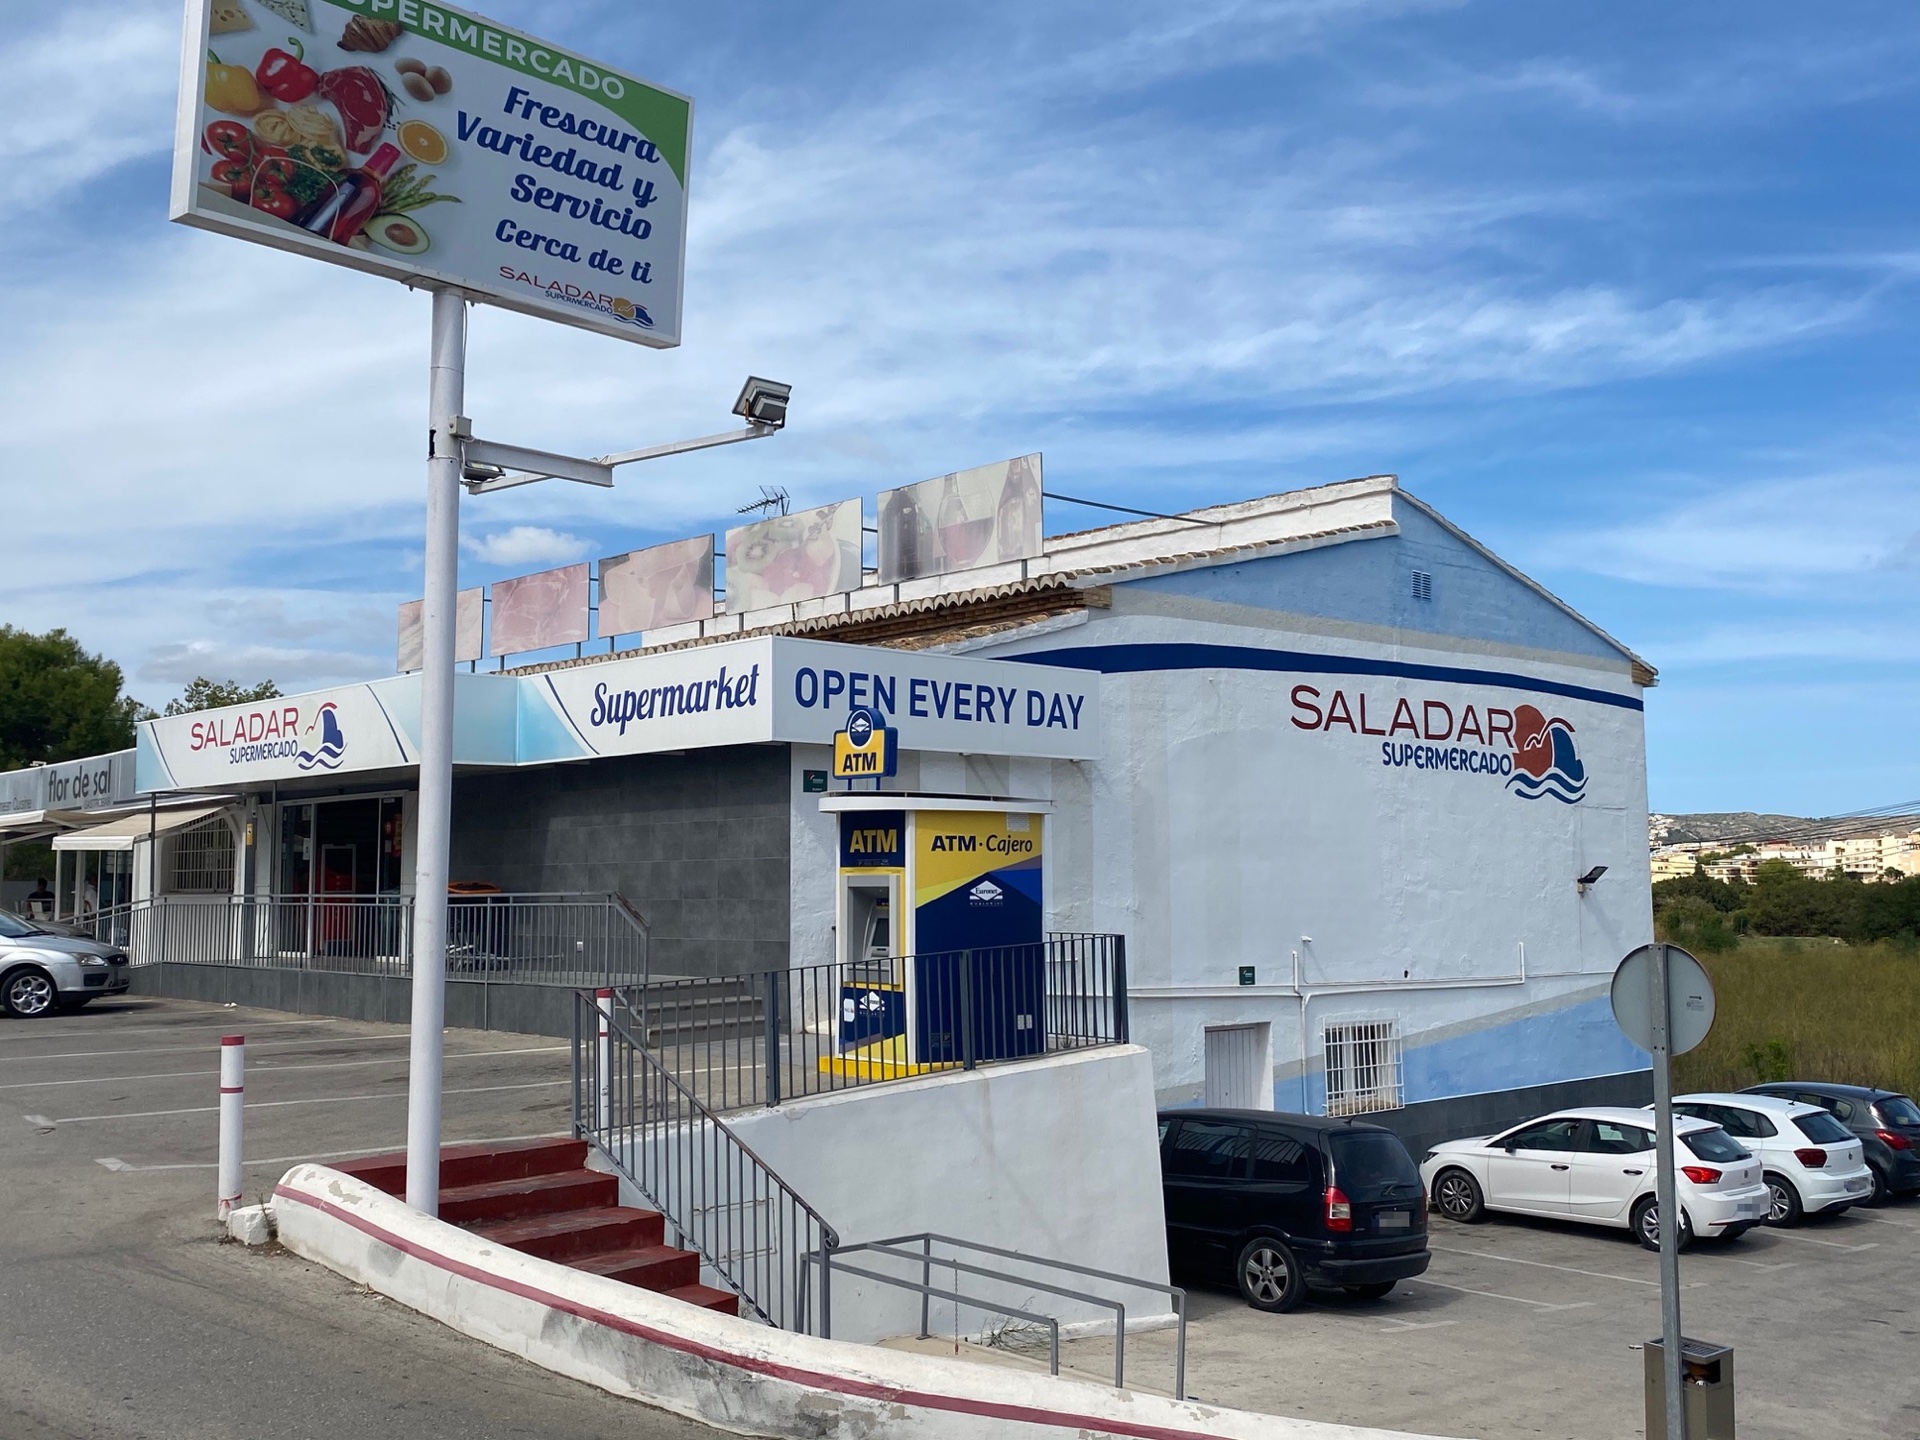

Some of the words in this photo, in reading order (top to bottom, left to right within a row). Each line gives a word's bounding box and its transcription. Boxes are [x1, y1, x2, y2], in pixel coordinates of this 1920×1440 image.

[503, 86, 660, 163] Frescura
[457, 110, 624, 191] Variedad
[632, 177, 658, 209] y
[510, 173, 652, 240] Servicio
[495, 218, 582, 263] Cerca
[588, 249, 624, 276] de
[630, 260, 653, 284] ti
[499, 266, 614, 307] SALADAR
[544, 289, 613, 315] SUPERMERCADO
[589, 663, 760, 737] Supermarket
[794, 666, 896, 715] OPEN
[909, 678, 1017, 725] EVERY
[1026, 689, 1085, 731] DAY
[1290, 684, 1514, 749] SALADAR
[190, 707, 299, 751] SALADAR
[229, 739, 298, 765] SUPERMERCADO
[842, 752, 877, 773] ATM
[1382, 741, 1513, 776] SUPERMERCADO
[48, 769, 69, 802] flor
[72, 765, 89, 799] de
[93, 759, 112, 796] sal
[849, 828, 898, 854] ATM
[931, 835, 977, 852] ATM
[985, 834, 1033, 856] Cajero
